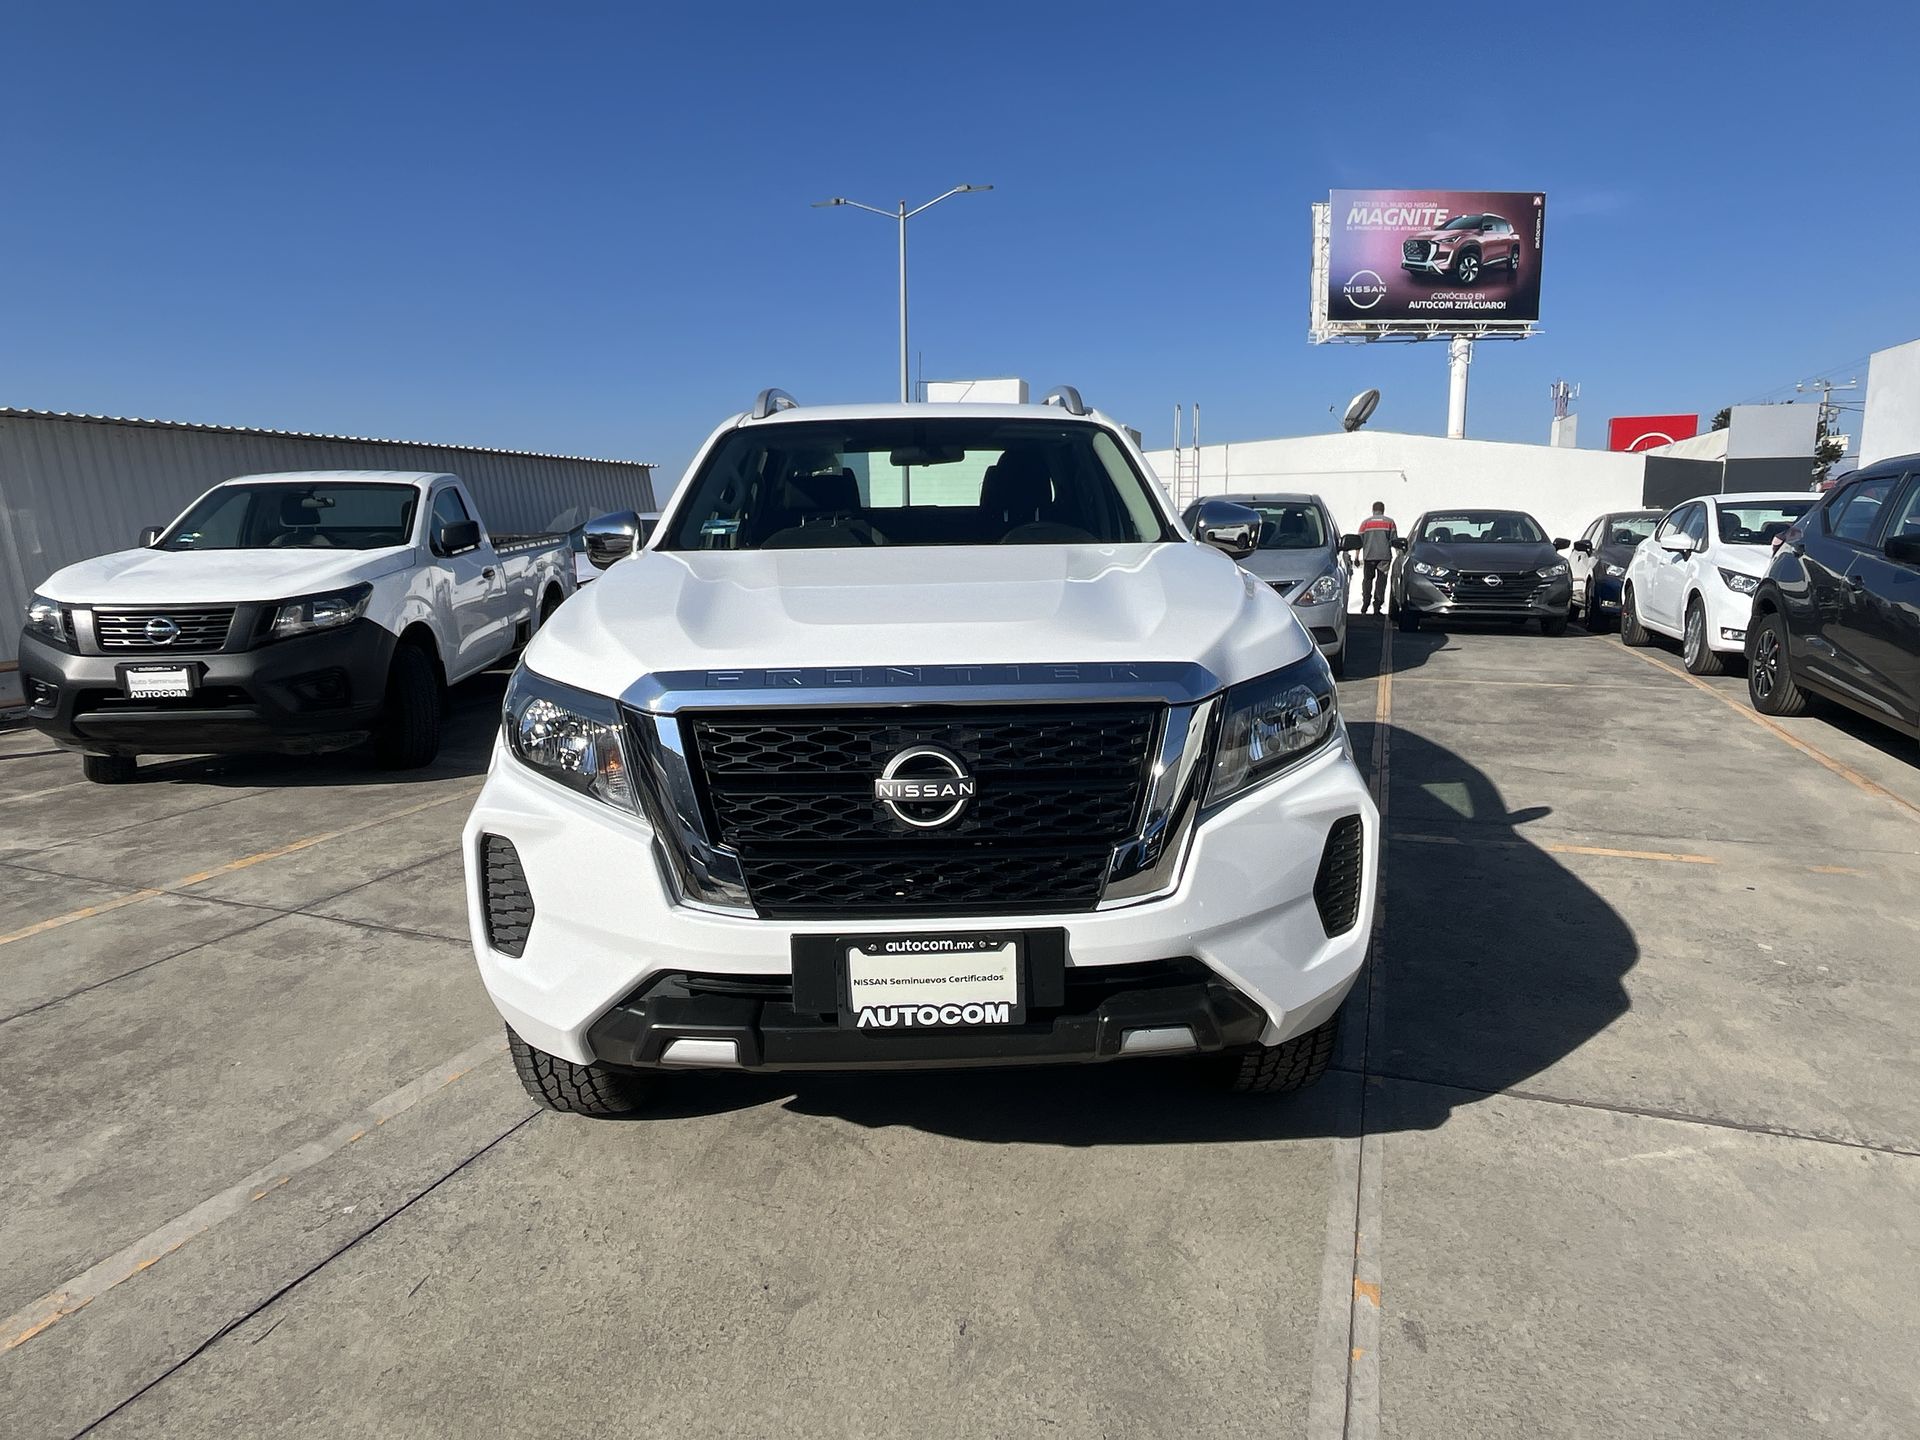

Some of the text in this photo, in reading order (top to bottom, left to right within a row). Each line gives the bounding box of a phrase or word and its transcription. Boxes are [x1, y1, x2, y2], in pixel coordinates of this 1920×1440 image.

[1346, 207, 1449, 226] MAGNITE
[1475, 292, 1486, 300] EN
[1408, 300, 1507, 309] AUTOCOM ZITÁCUARO!
[705, 663, 1139, 687] FRONTIER
[130, 690, 187, 699] AUTOCOM
[879, 782, 974, 798] NISSAN
[885, 939, 975, 952] autocom.mx
[853, 974, 1005, 986] NISSAN Seminuevos Certificados
[856, 1004, 1009, 1028] AUTOCOM
